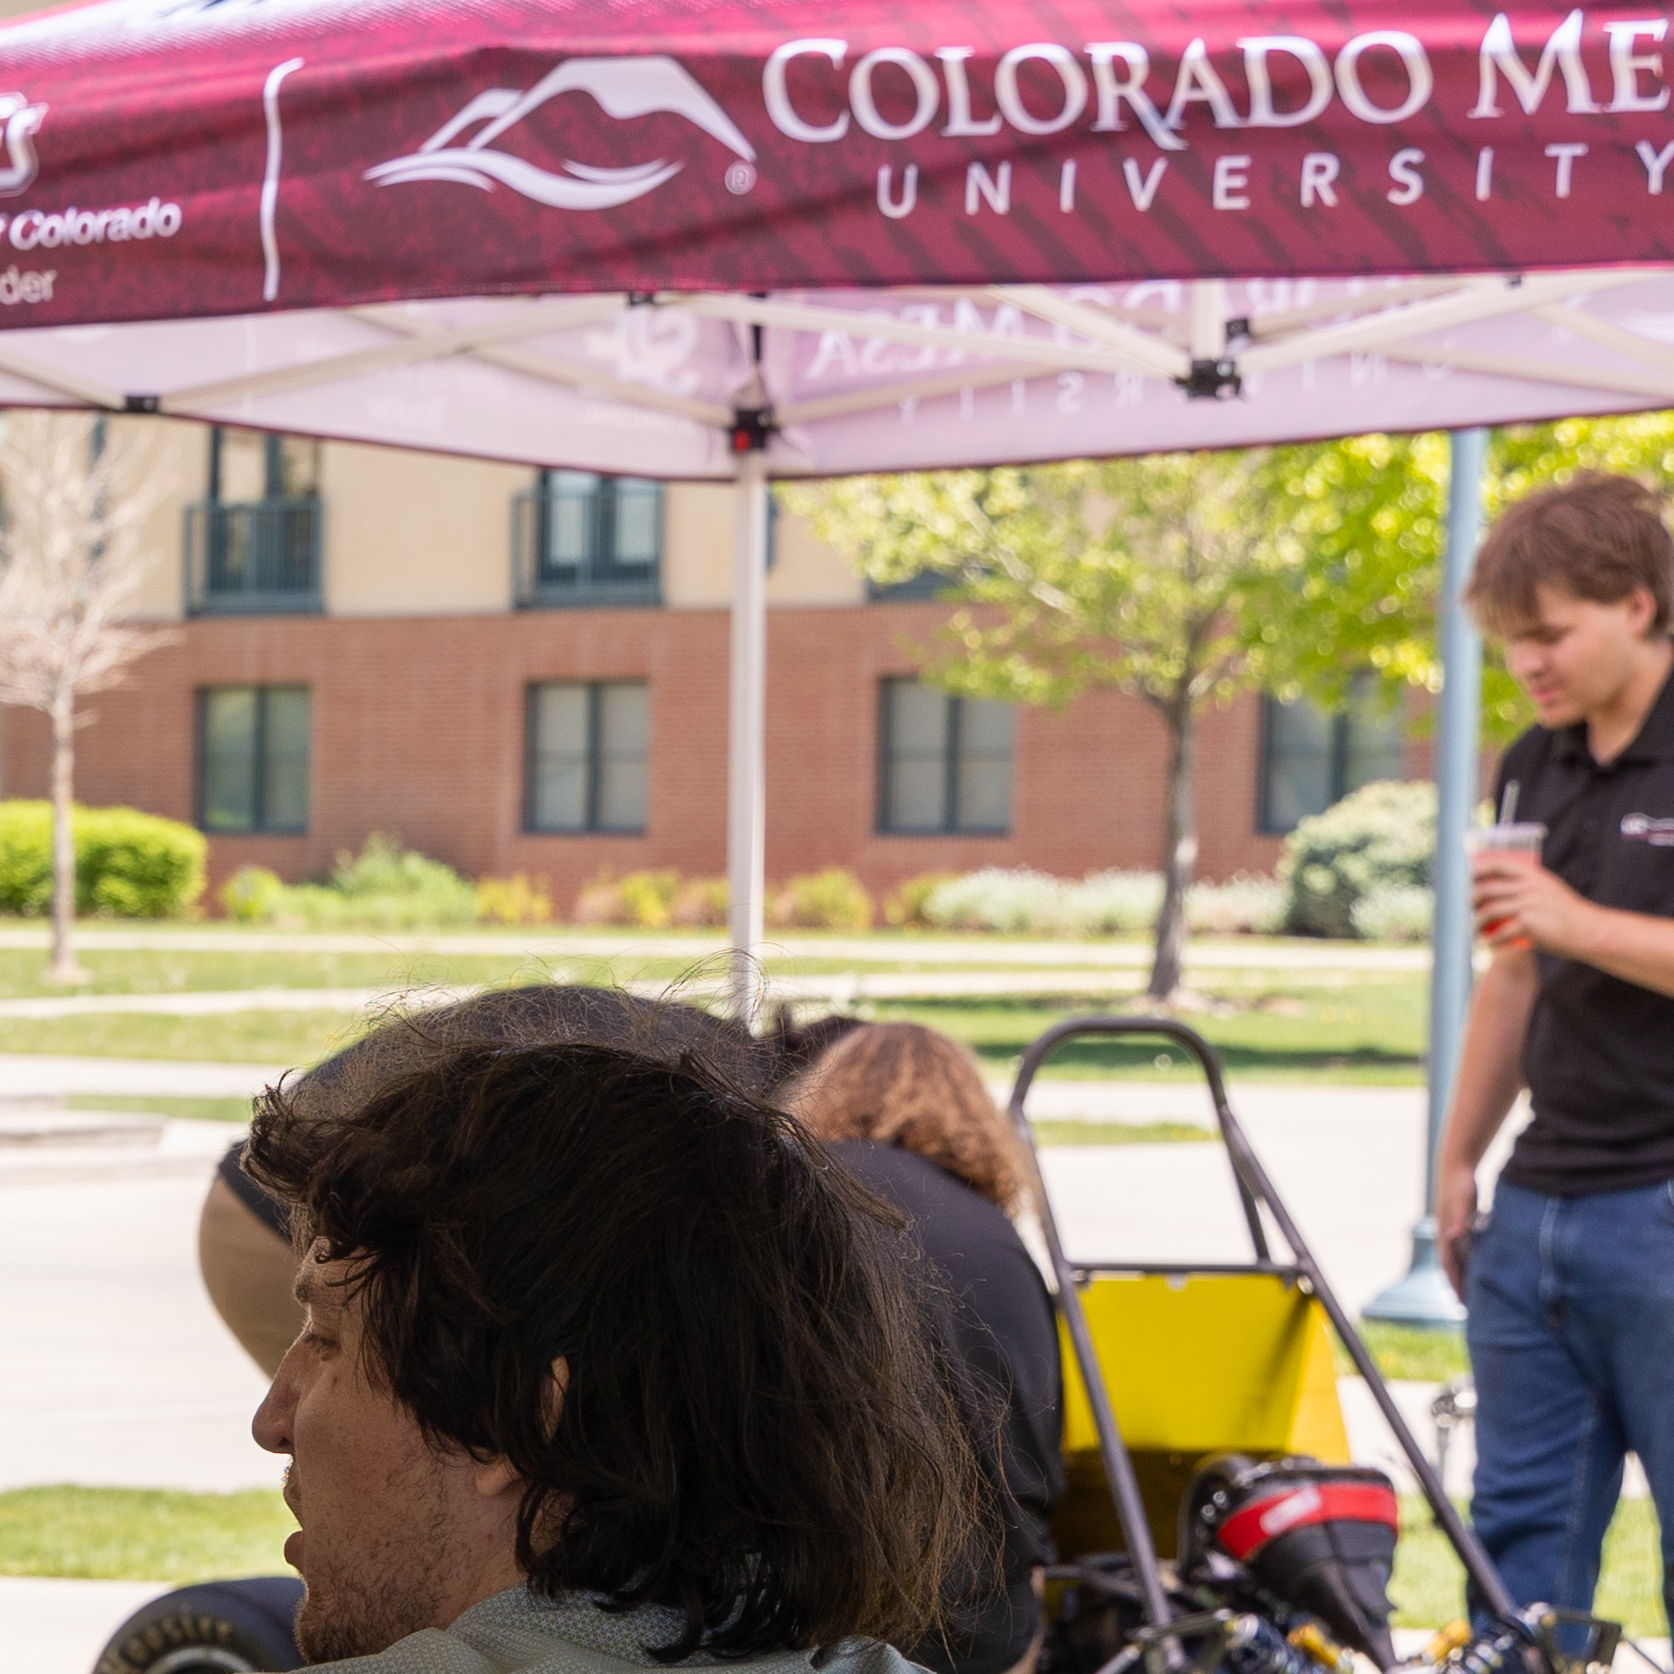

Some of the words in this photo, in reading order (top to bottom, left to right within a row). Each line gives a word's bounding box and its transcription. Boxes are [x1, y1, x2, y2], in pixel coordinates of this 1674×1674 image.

[762, 30, 1434, 151] COLORADO
[1466, 8, 1672, 119] ME
[876, 139, 1674, 219] UNIVERSITY
[8, 197, 184, 244] Colorado
